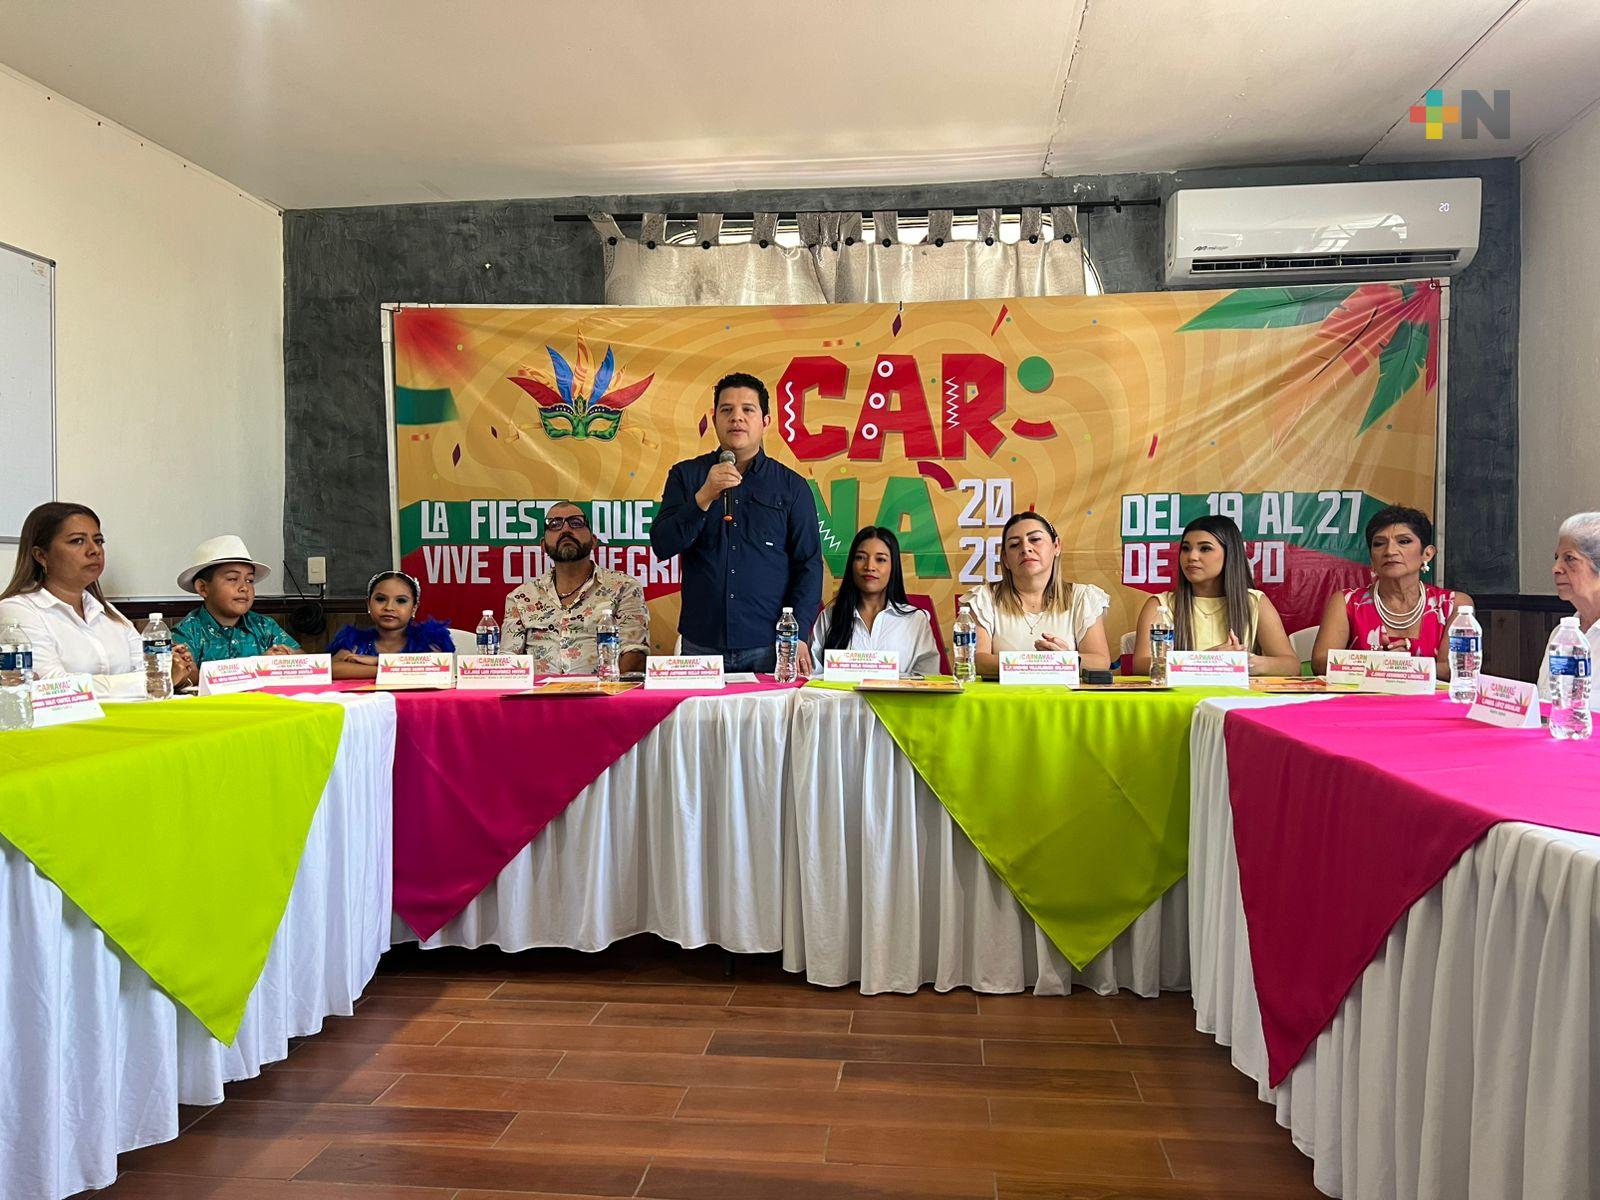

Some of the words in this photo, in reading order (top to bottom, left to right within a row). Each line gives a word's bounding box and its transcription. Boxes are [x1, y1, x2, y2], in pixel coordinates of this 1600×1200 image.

[1439, 202, 1450, 212] 20
[776, 353, 1007, 462] CAR
[421, 500, 449, 539] LA
[471, 500, 569, 539] FIEST
[592, 500, 653, 543] QUE
[957, 478, 1012, 528] 20
[1121, 493, 1186, 536] DEL
[1206, 493, 1244, 532] 19
[1258, 492, 1304, 534] AL
[1317, 491, 1363, 534] 27
[422, 545, 491, 584] VIVE
[1123, 542, 1171, 584] DE
